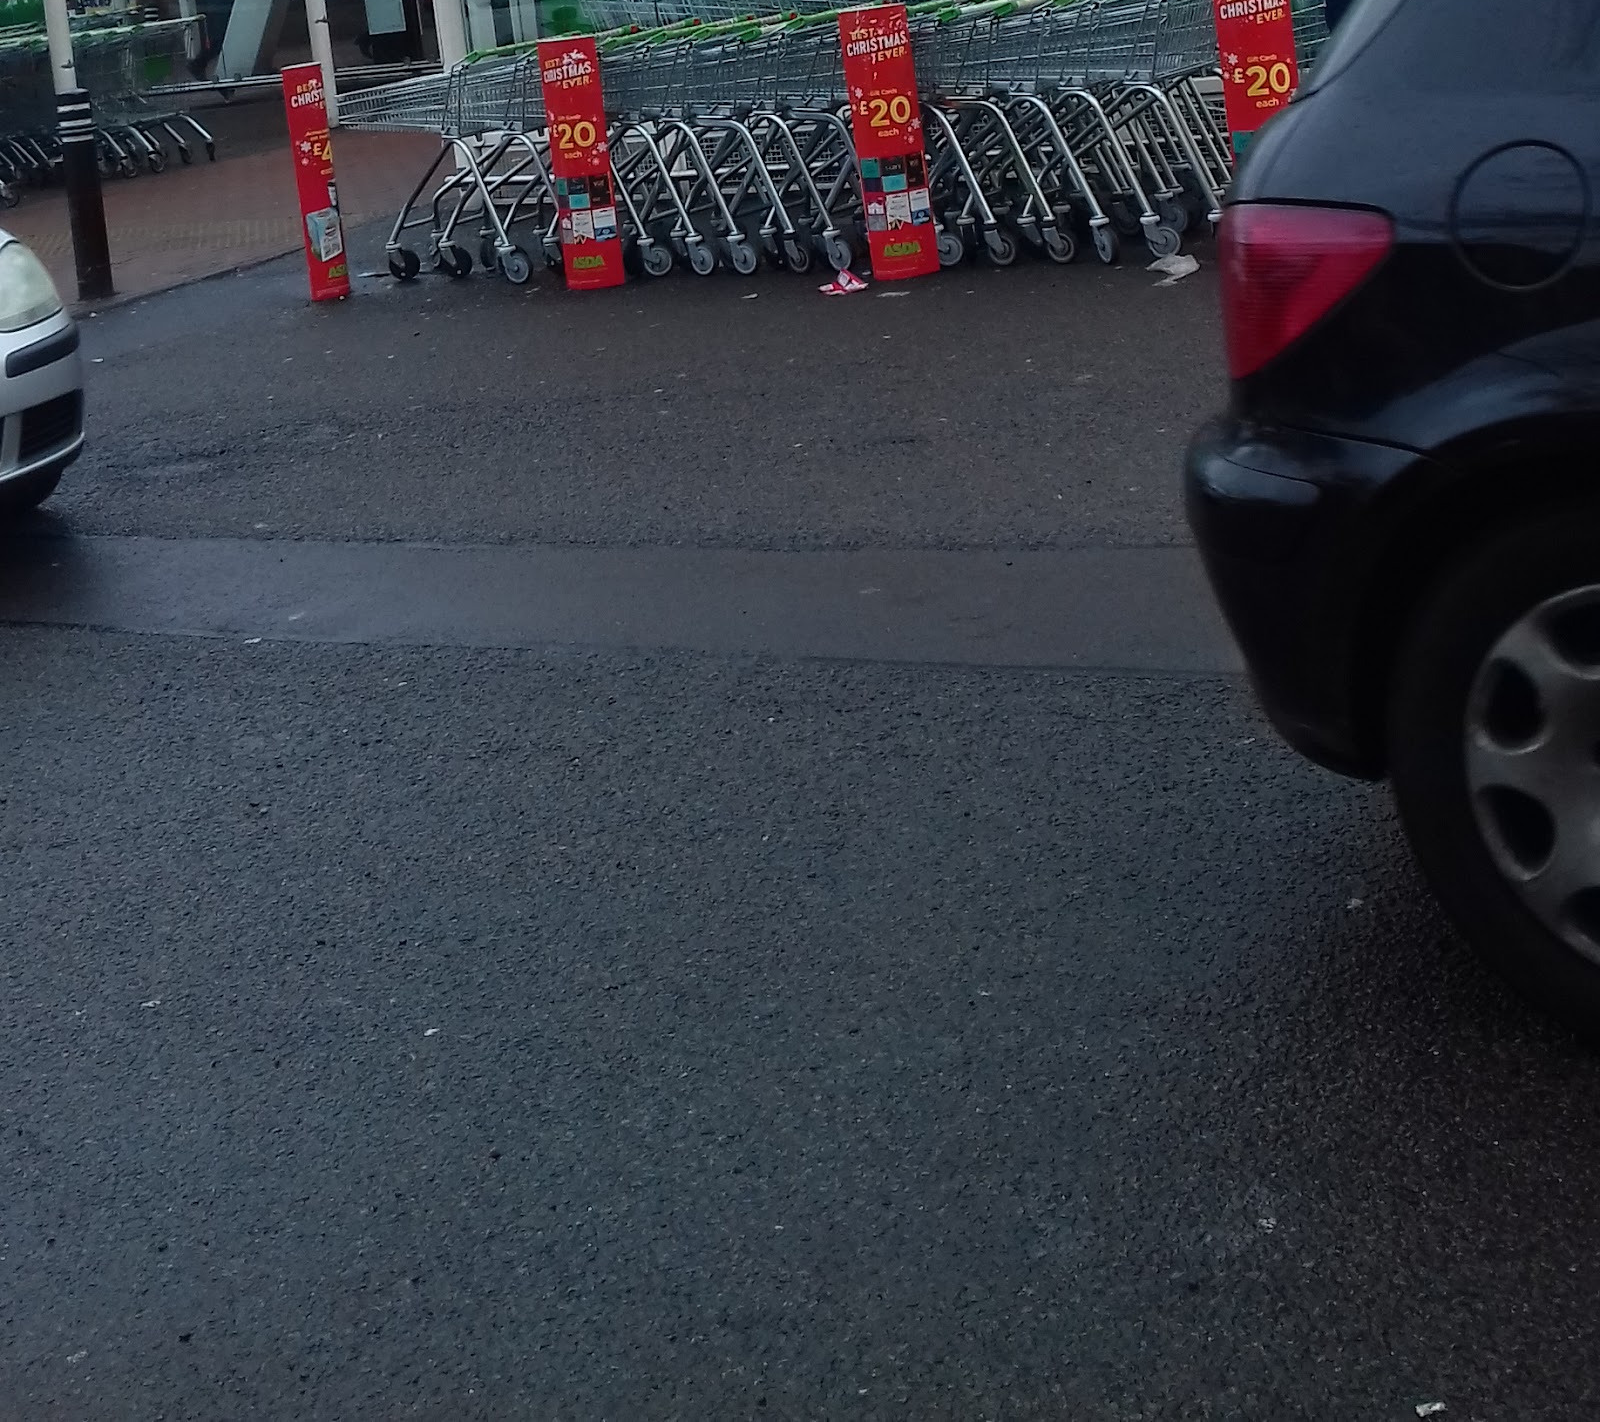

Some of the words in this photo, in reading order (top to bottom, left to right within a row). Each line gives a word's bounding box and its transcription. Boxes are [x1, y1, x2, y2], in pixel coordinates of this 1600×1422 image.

[1233, 62, 1291, 97] £20
[860, 95, 911, 127] £20
[1256, 97, 1280, 108] each
[552, 121, 596, 149] £20
[878, 127, 899, 137] each
[884, 241, 920, 257] ASDA
